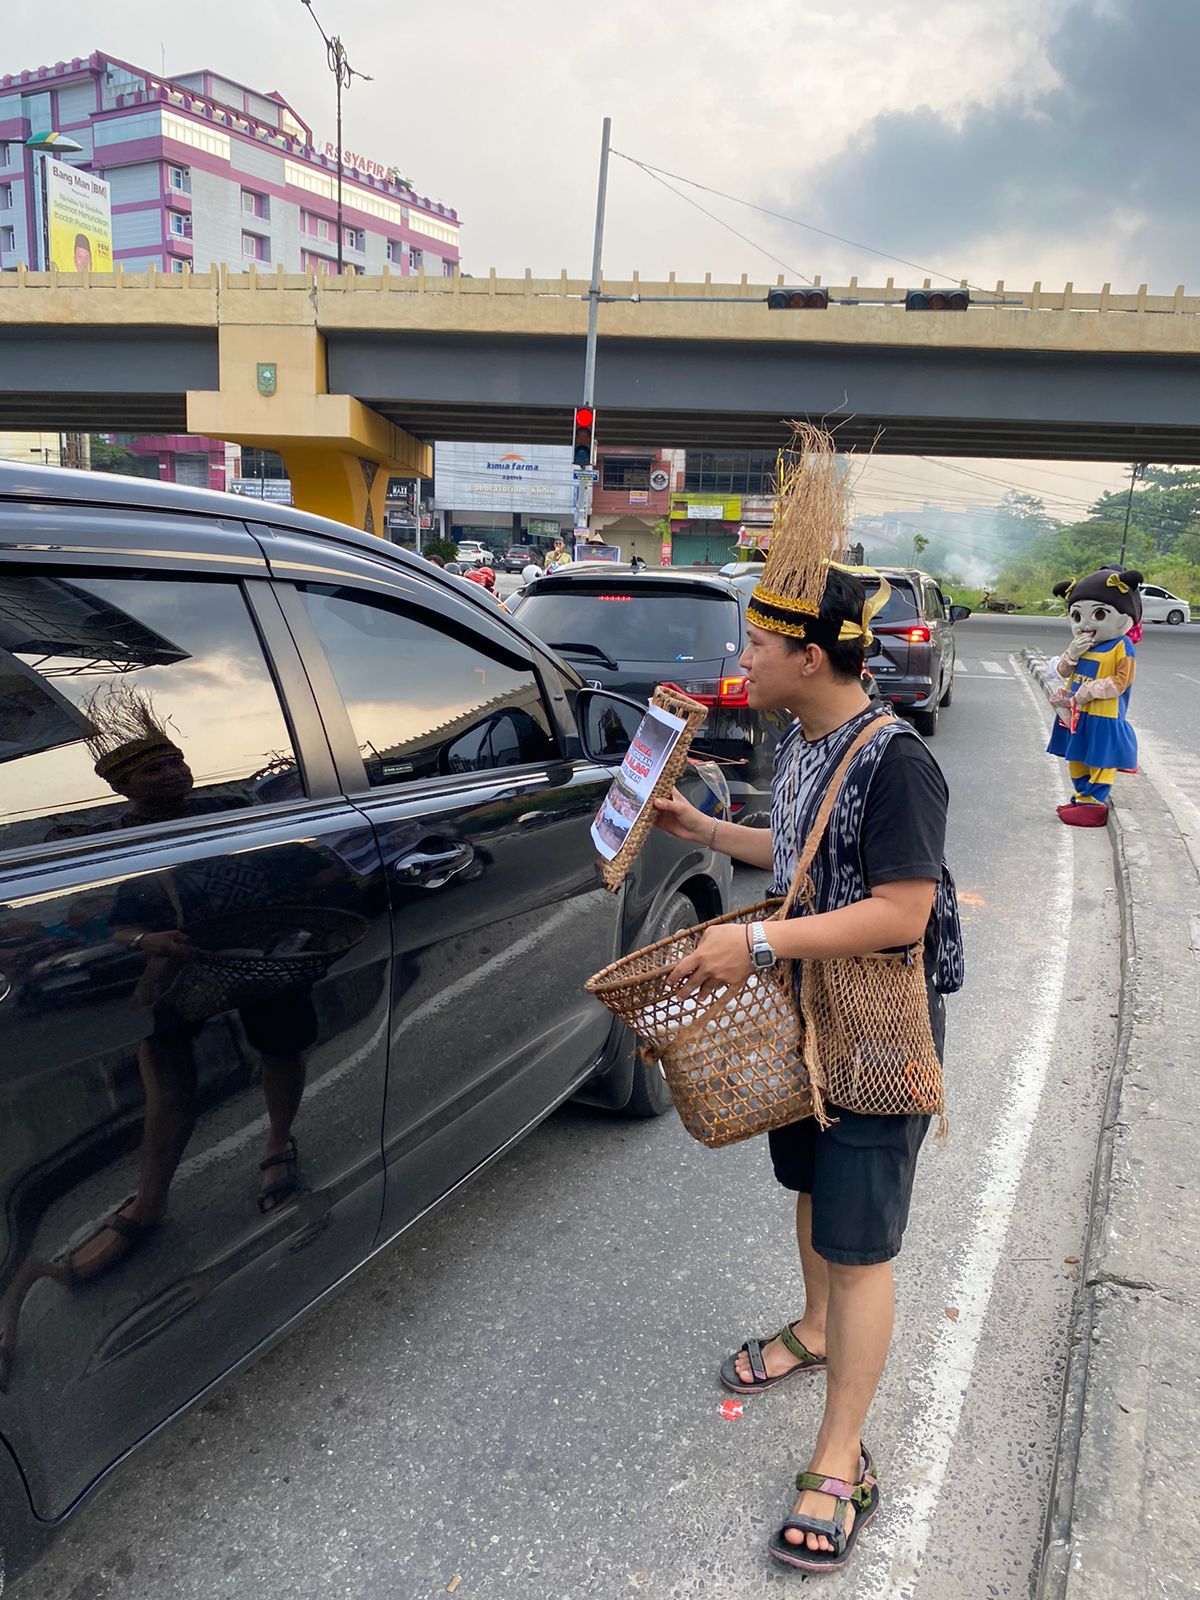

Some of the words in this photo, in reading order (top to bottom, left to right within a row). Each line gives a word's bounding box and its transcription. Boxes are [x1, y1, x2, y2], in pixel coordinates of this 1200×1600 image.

[52, 166, 73, 186] Bang
[74, 175, 90, 190] Man
[486, 462, 510, 470] kimia
[511, 462, 539, 471] farma
